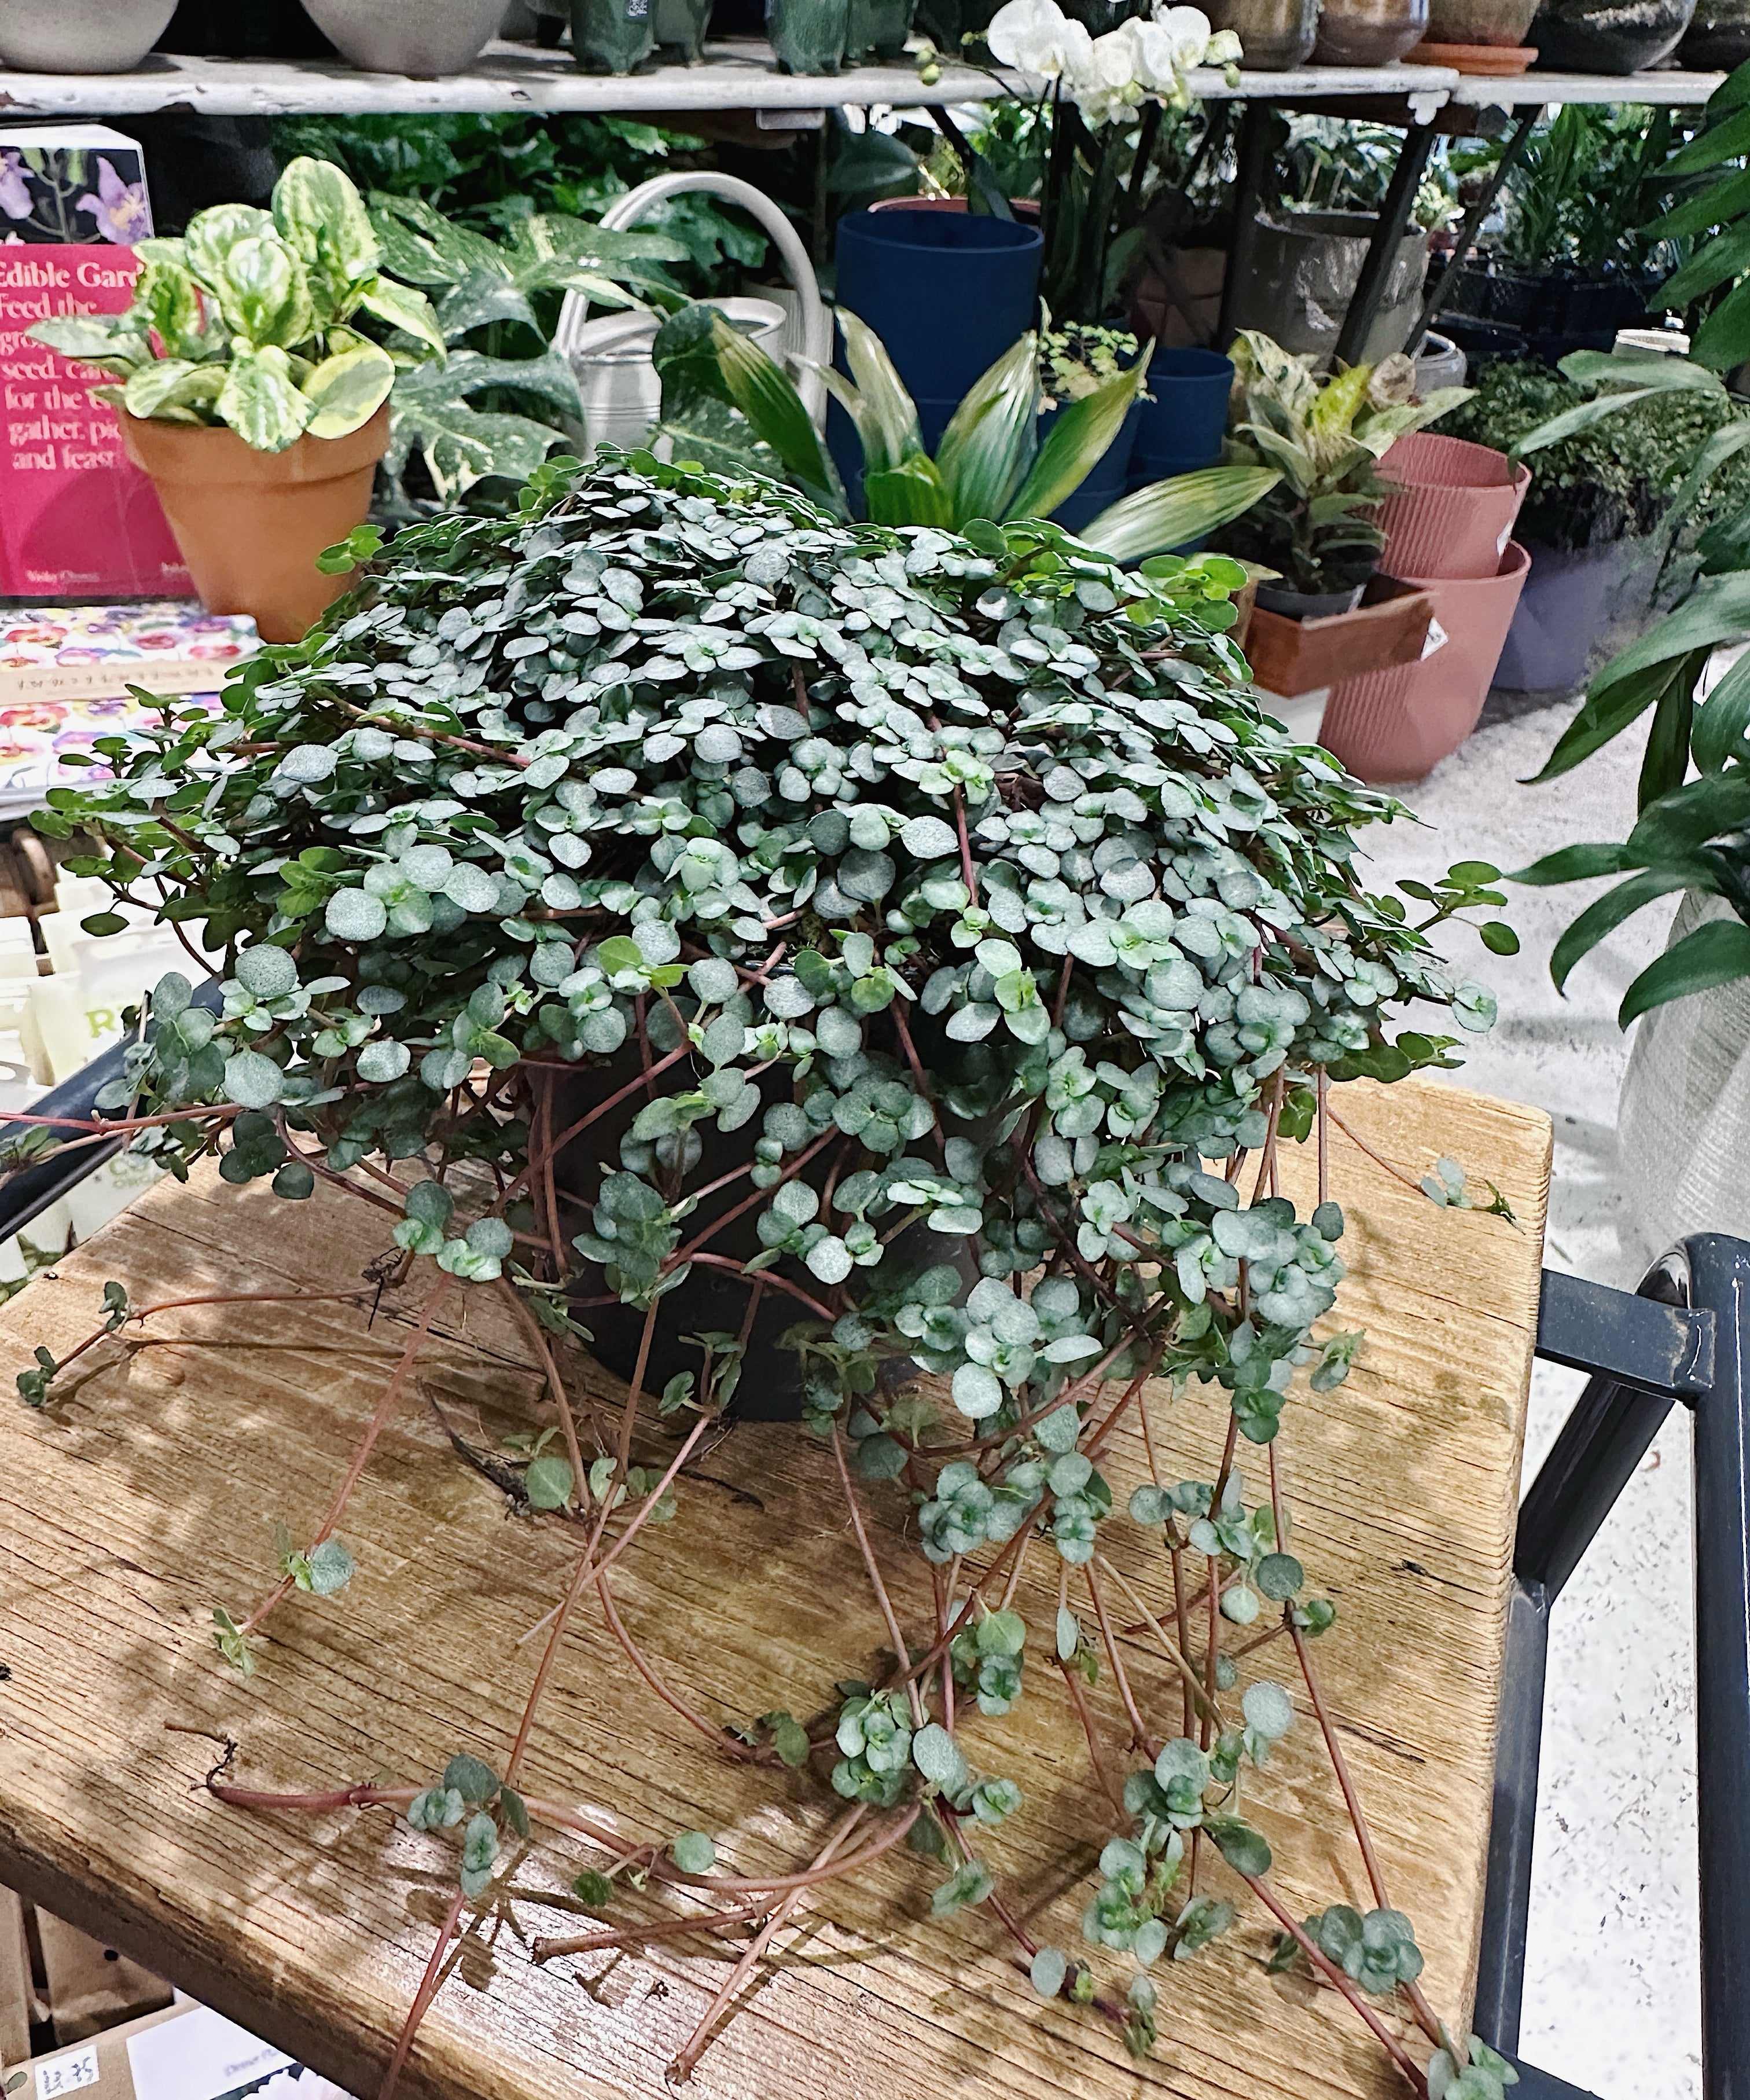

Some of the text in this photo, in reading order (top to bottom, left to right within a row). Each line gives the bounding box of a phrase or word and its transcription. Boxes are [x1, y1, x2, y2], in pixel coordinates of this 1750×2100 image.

[5, 384, 37, 410] for
[44, 384, 82, 410] the
[13, 443, 56, 470] and
